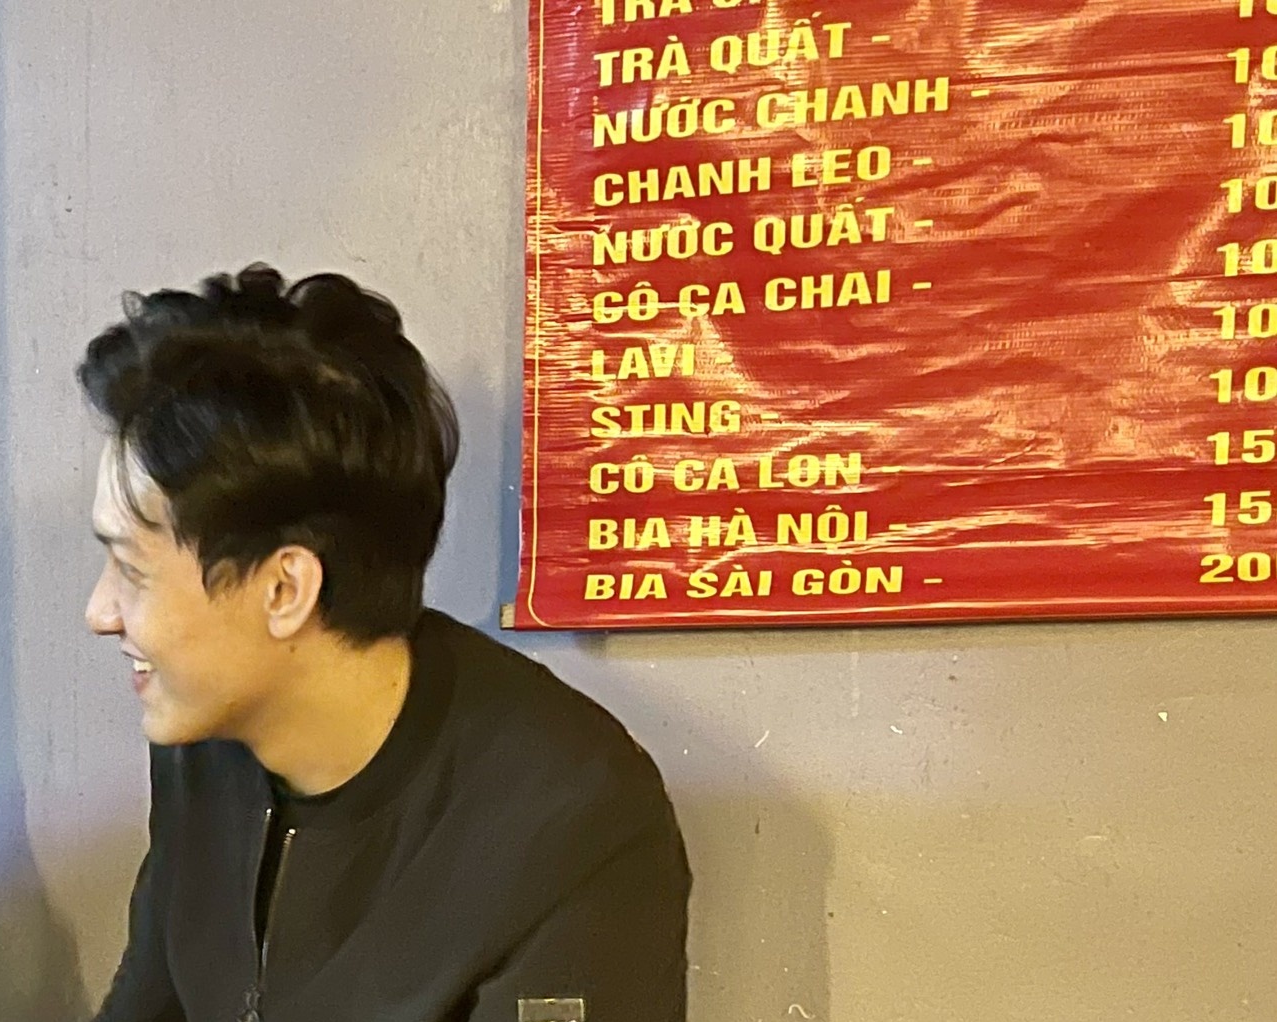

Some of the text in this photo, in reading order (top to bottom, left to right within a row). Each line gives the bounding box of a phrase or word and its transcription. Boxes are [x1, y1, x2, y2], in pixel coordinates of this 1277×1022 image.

[593, 35, 690, 87] TRÀ
[709, 12, 852, 74] QUẤT
[756, 77, 949, 130] CHANH
[593, 157, 771, 206] CHANH
[791, 146, 891, 188] LEO
[753, 197, 894, 255] QUẤT
[592, 282, 659, 322] CÔ
[678, 284, 746, 317] CA
[764, 269, 891, 311] CHAI
[591, 344, 695, 381] LAVI
[1213, 303, 1277, 340] 10
[590, 401, 741, 437] STING
[1209, 366, 1277, 403] 10
[589, 455, 656, 494] CÔ
[673, 457, 740, 491] CA
[758, 452, 861, 488] LON
[1206, 430, 1275, 465] 15
[588, 517, 671, 550] BIA
[688, 508, 755, 548] HÀ
[777, 505, 868, 554] NỘI
[1203, 491, 1272, 526] 15
[584, 573, 668, 600] BIA
[686, 563, 772, 598] SÀI
[792, 560, 903, 596] GÒN
[1199, 552, 1271, 583] 20
